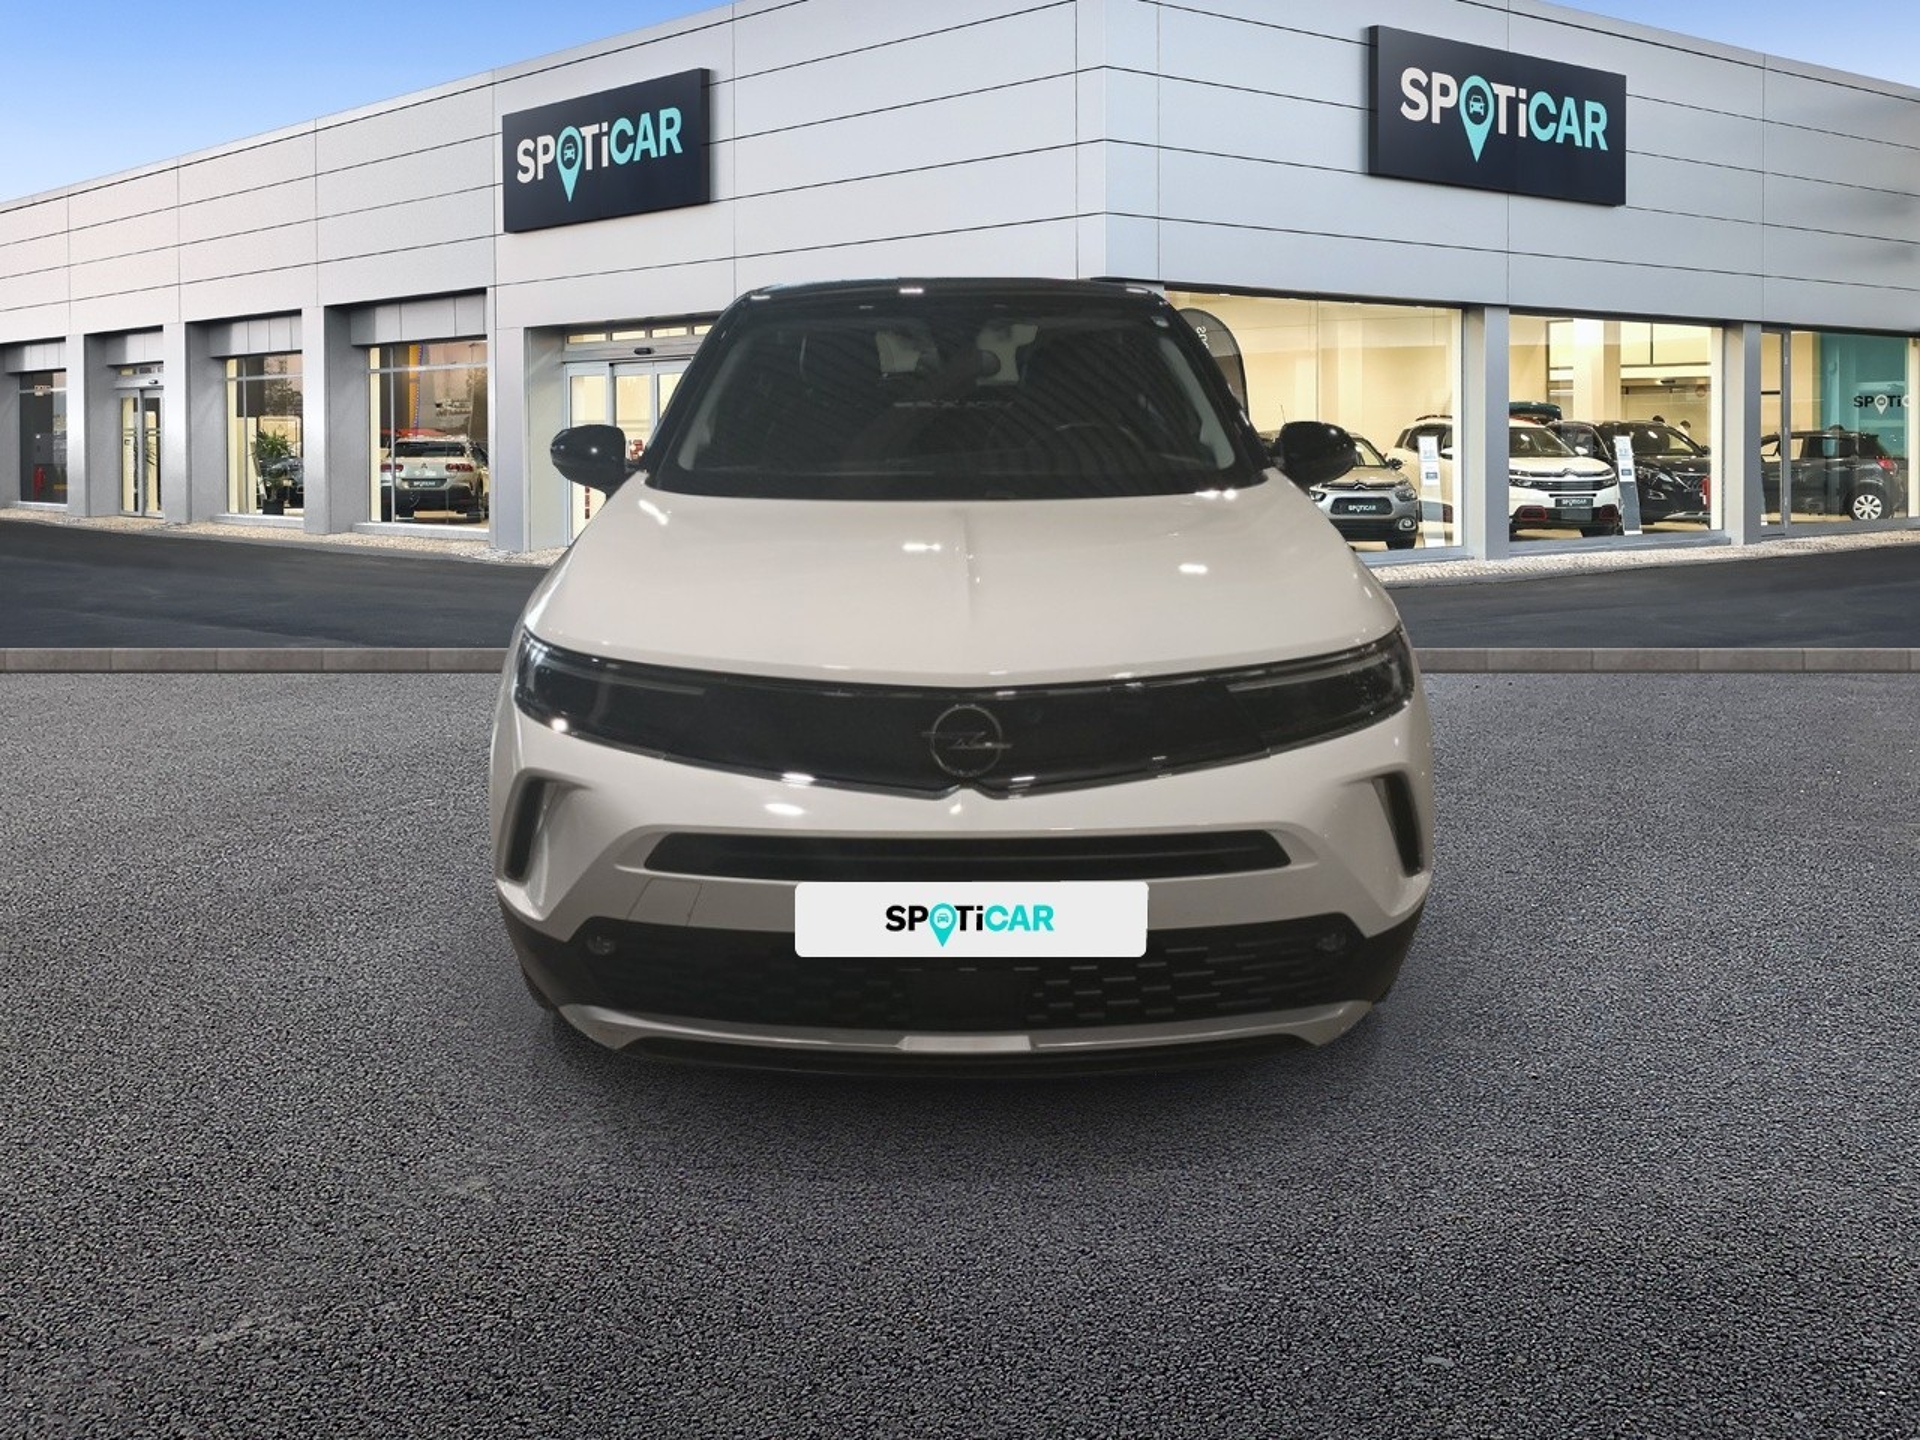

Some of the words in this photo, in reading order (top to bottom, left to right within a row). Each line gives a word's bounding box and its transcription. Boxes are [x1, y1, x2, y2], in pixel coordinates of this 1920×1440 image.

[517, 107, 682, 202] SPOTiCAR
[1401, 67, 1608, 162] SPOTiCAR
[886, 903, 1054, 947] SPOTiCAR
